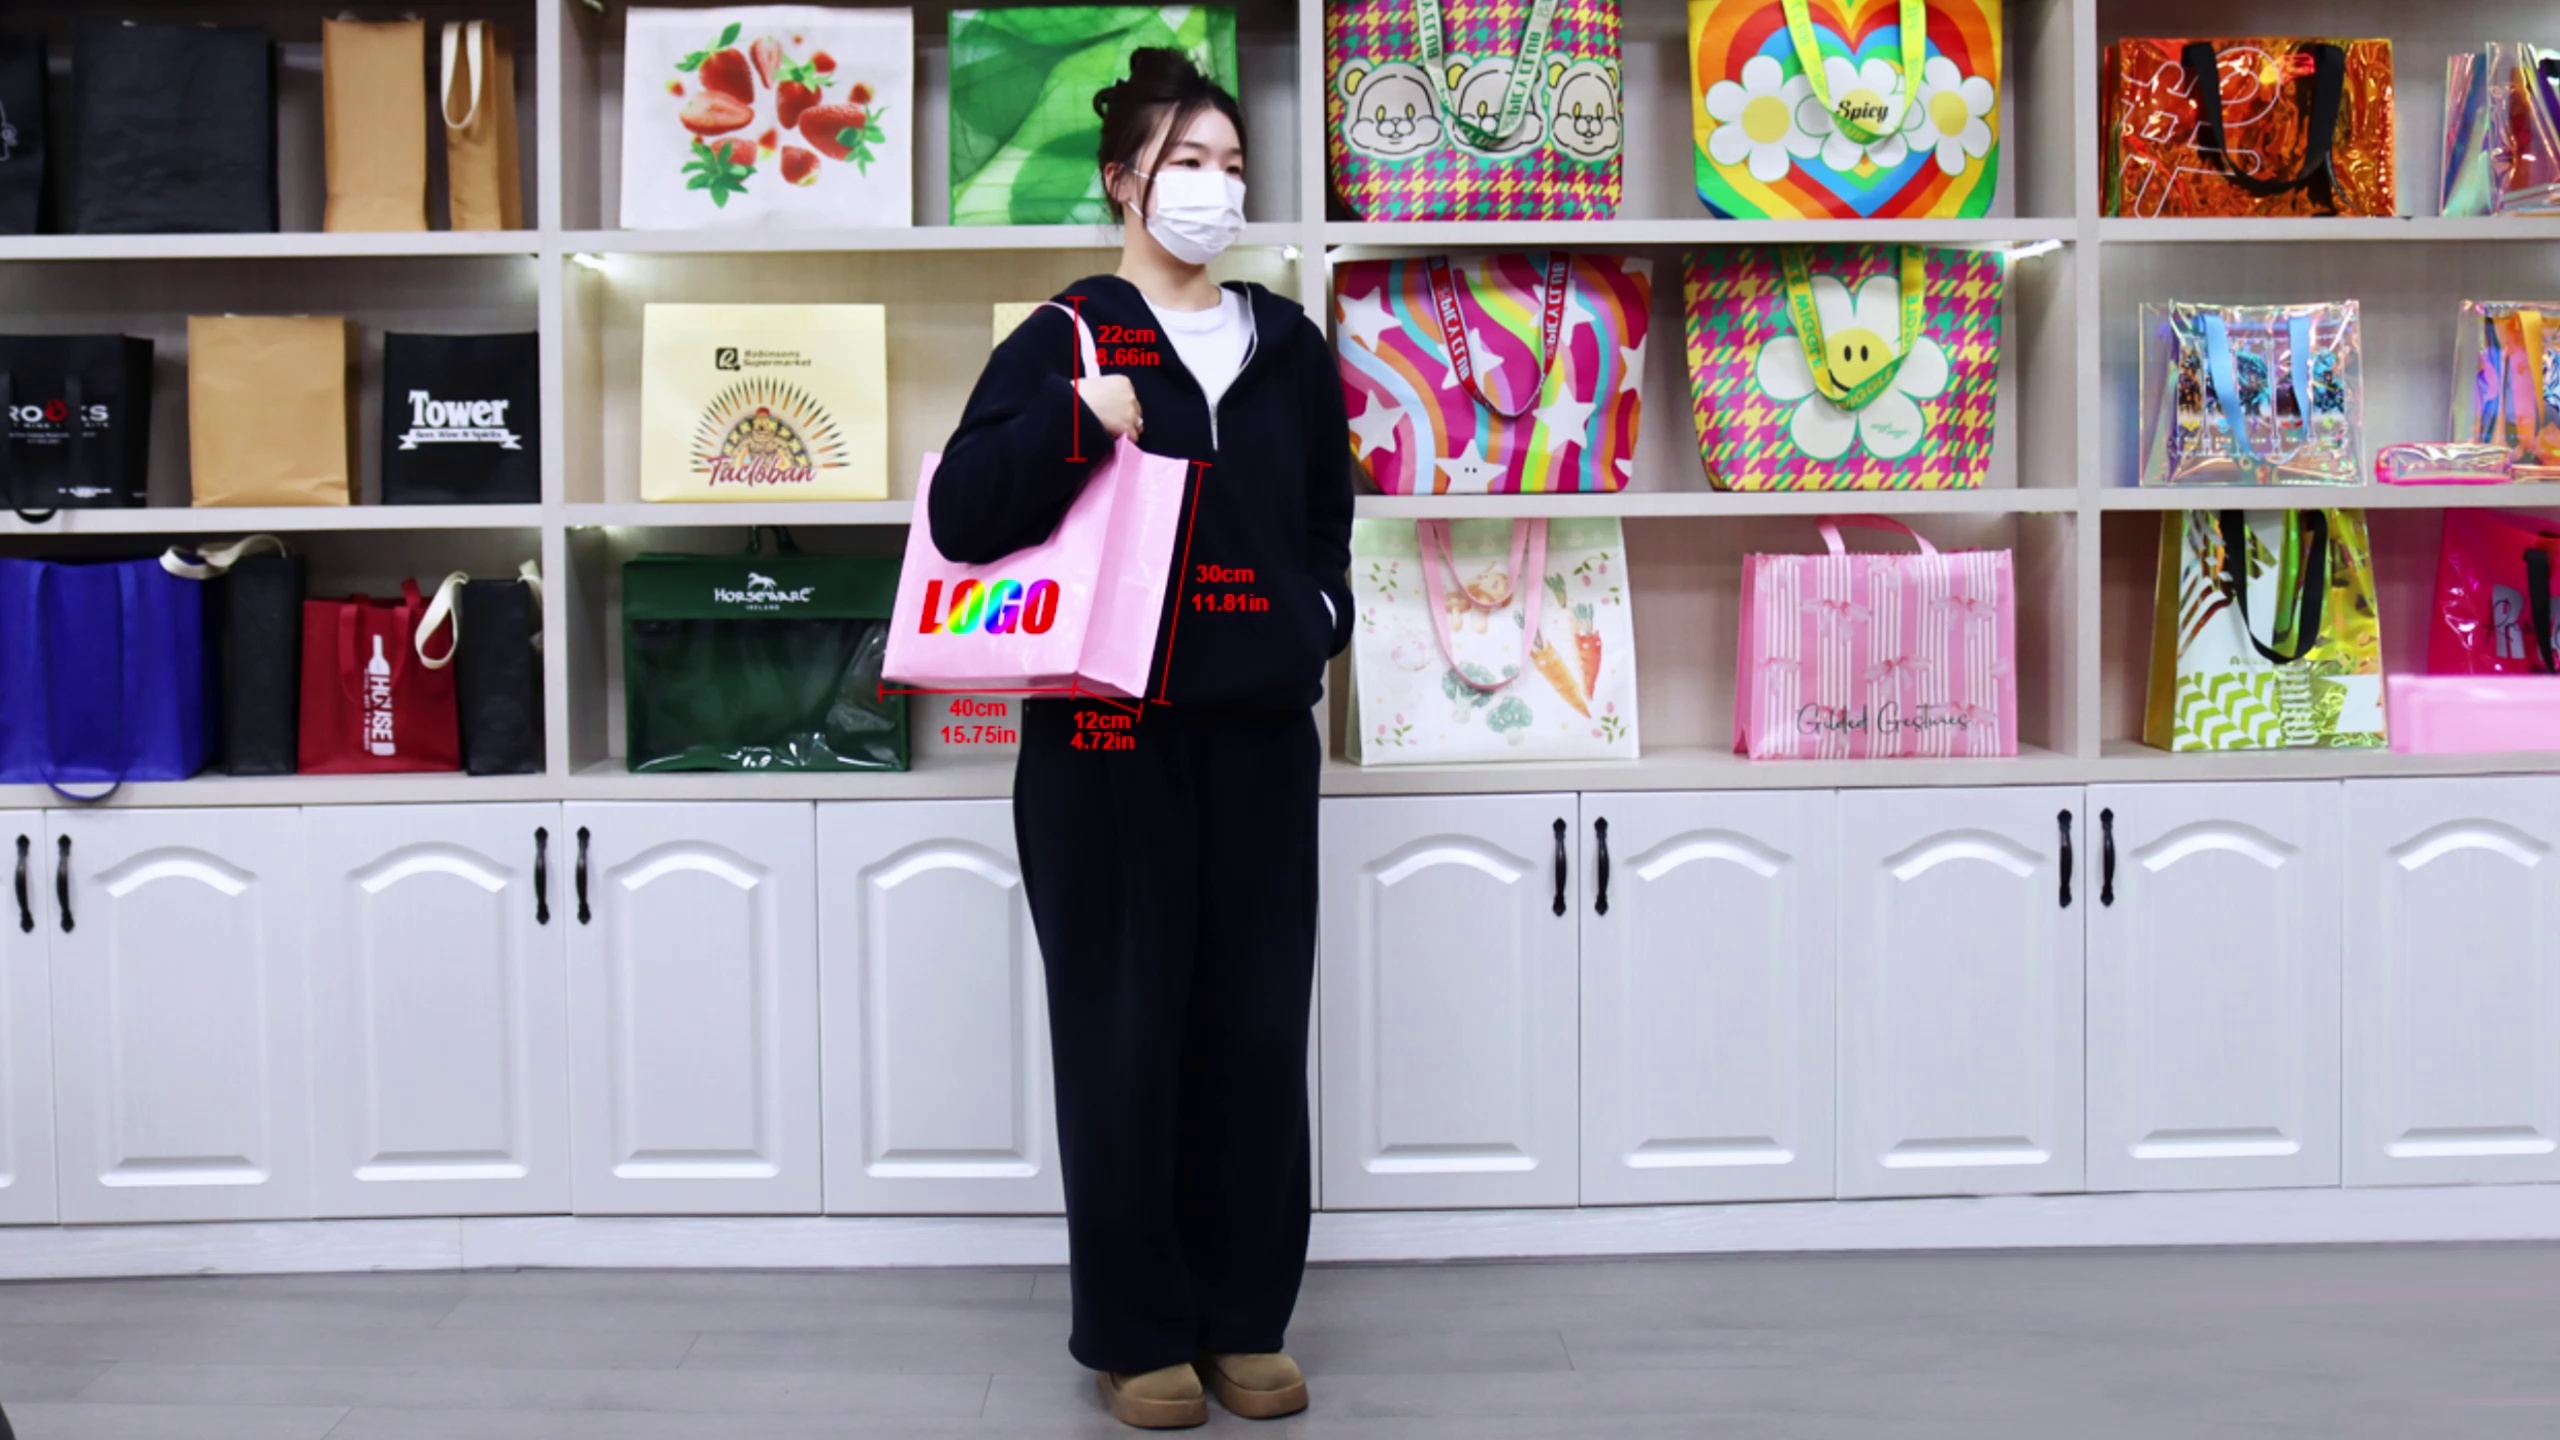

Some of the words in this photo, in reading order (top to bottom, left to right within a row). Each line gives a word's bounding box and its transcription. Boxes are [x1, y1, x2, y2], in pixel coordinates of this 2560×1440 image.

[1836, 100, 1889, 124] Spicy
[743, 359, 812, 368] Supermarket
[408, 389, 509, 428] Tower
[707, 456, 817, 487] Tacloban
[918, 578, 1061, 635] LOGO
[1797, 702, 1869, 735] Gilded
[1876, 701, 1972, 735] Gestures
